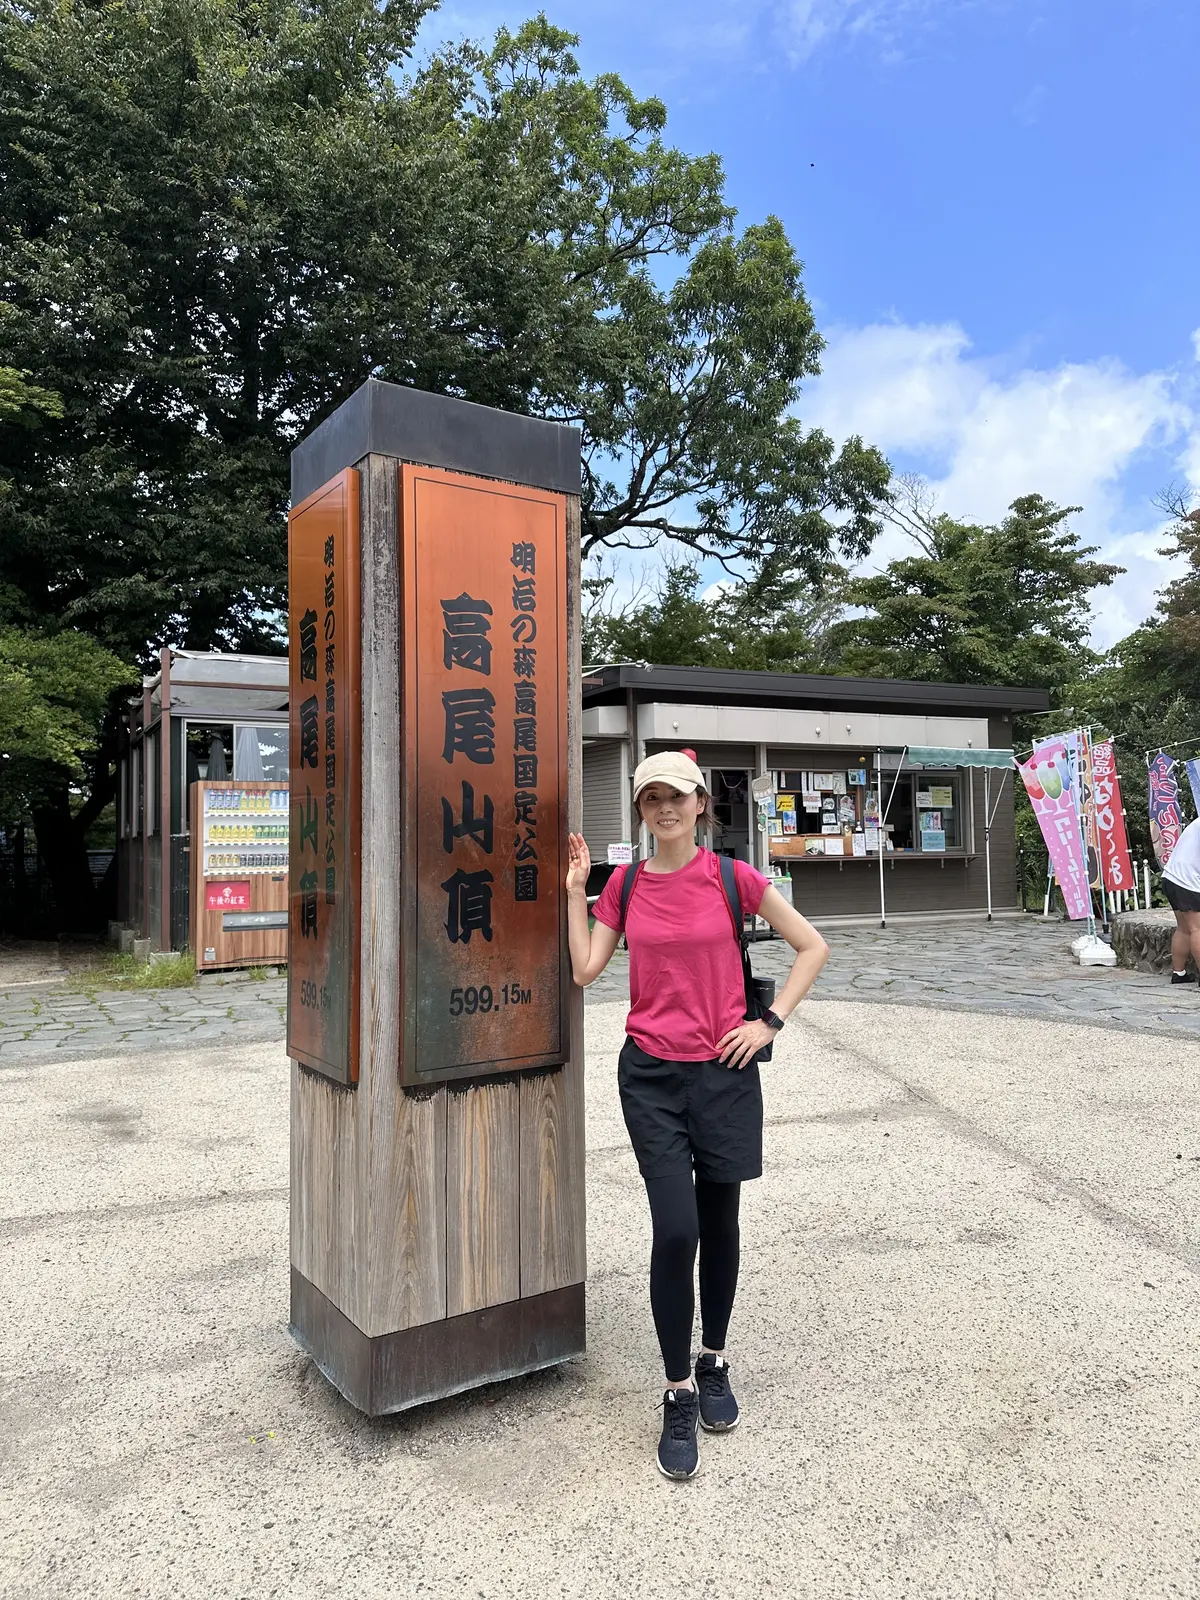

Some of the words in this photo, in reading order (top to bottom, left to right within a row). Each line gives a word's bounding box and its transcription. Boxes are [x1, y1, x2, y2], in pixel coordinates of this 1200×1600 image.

[299, 607, 319, 941] 高尾山頂
[440, 591, 495, 945] 高尾山頂
[510, 540, 538, 902] 明治の森高尾国定公園
[209, 895, 246, 906] 午後の紅茶
[449, 983, 532, 1017] 599.15M
